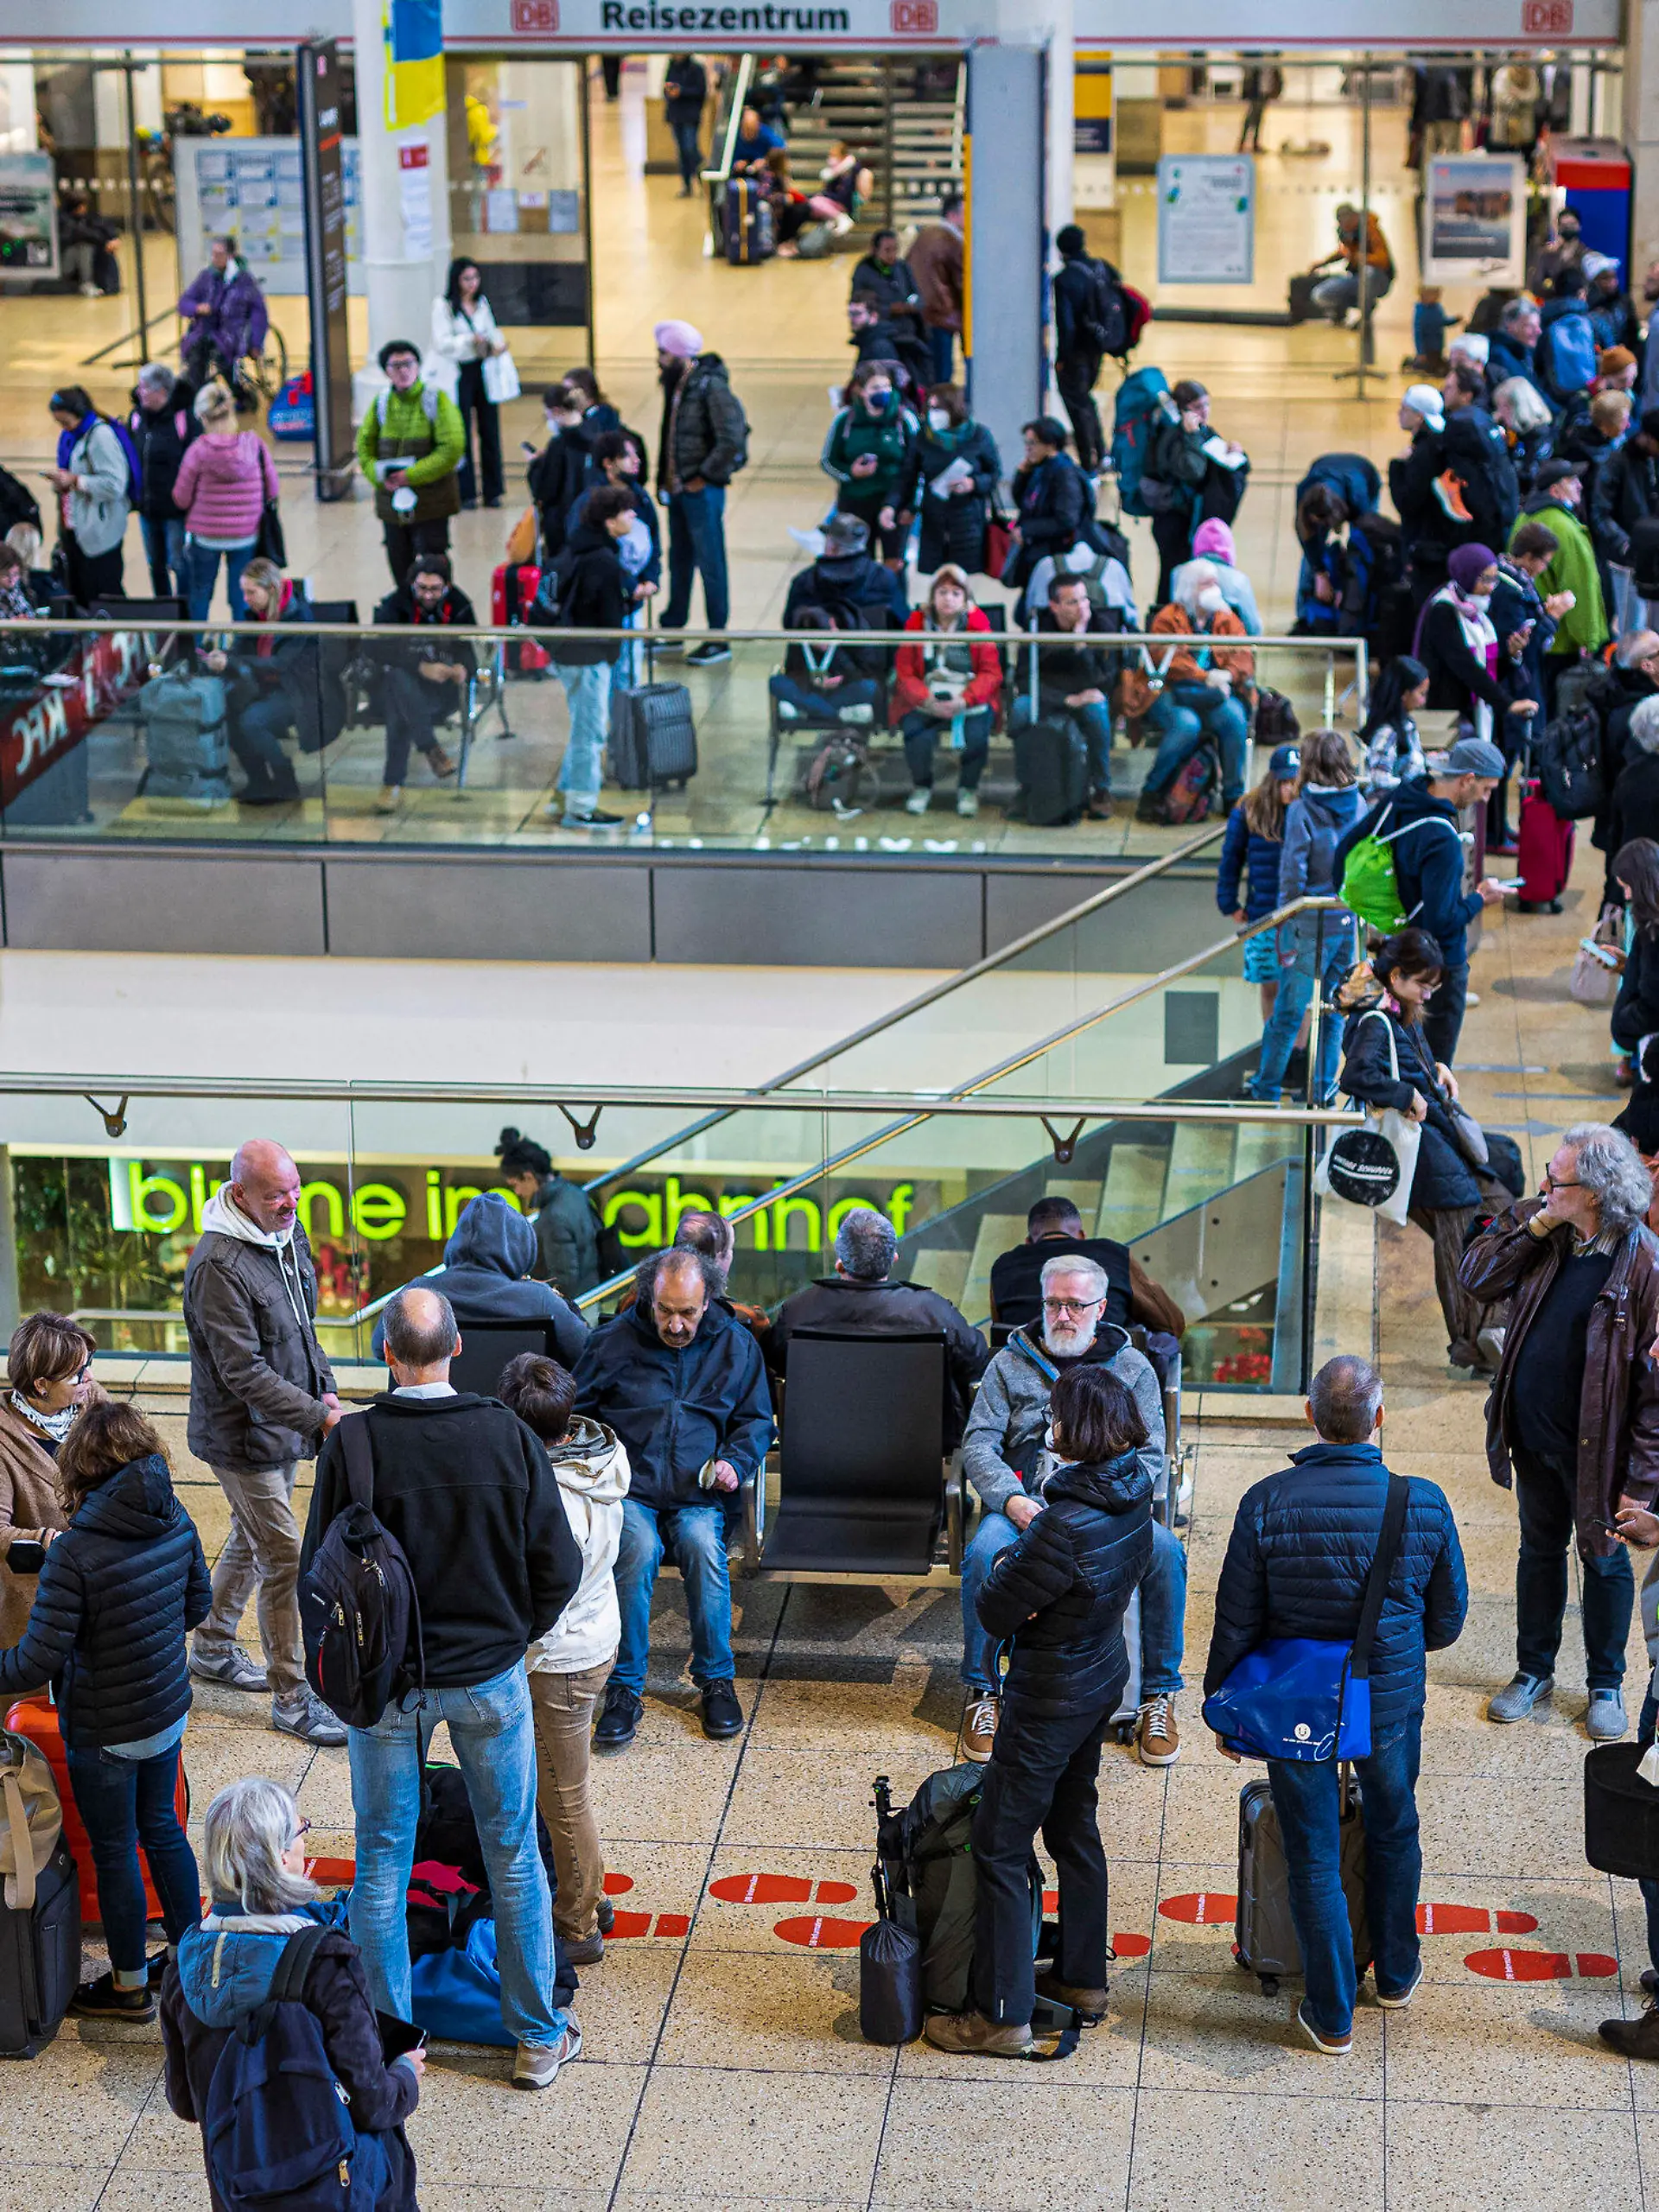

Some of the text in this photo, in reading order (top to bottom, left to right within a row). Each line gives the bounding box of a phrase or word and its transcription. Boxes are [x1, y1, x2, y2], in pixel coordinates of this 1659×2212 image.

[515, 1, 556, 29] DB
[602, 0, 850, 30] Reisezentrum
[894, 1, 933, 30] DB
[589, 1177, 914, 1253] ahnhof
